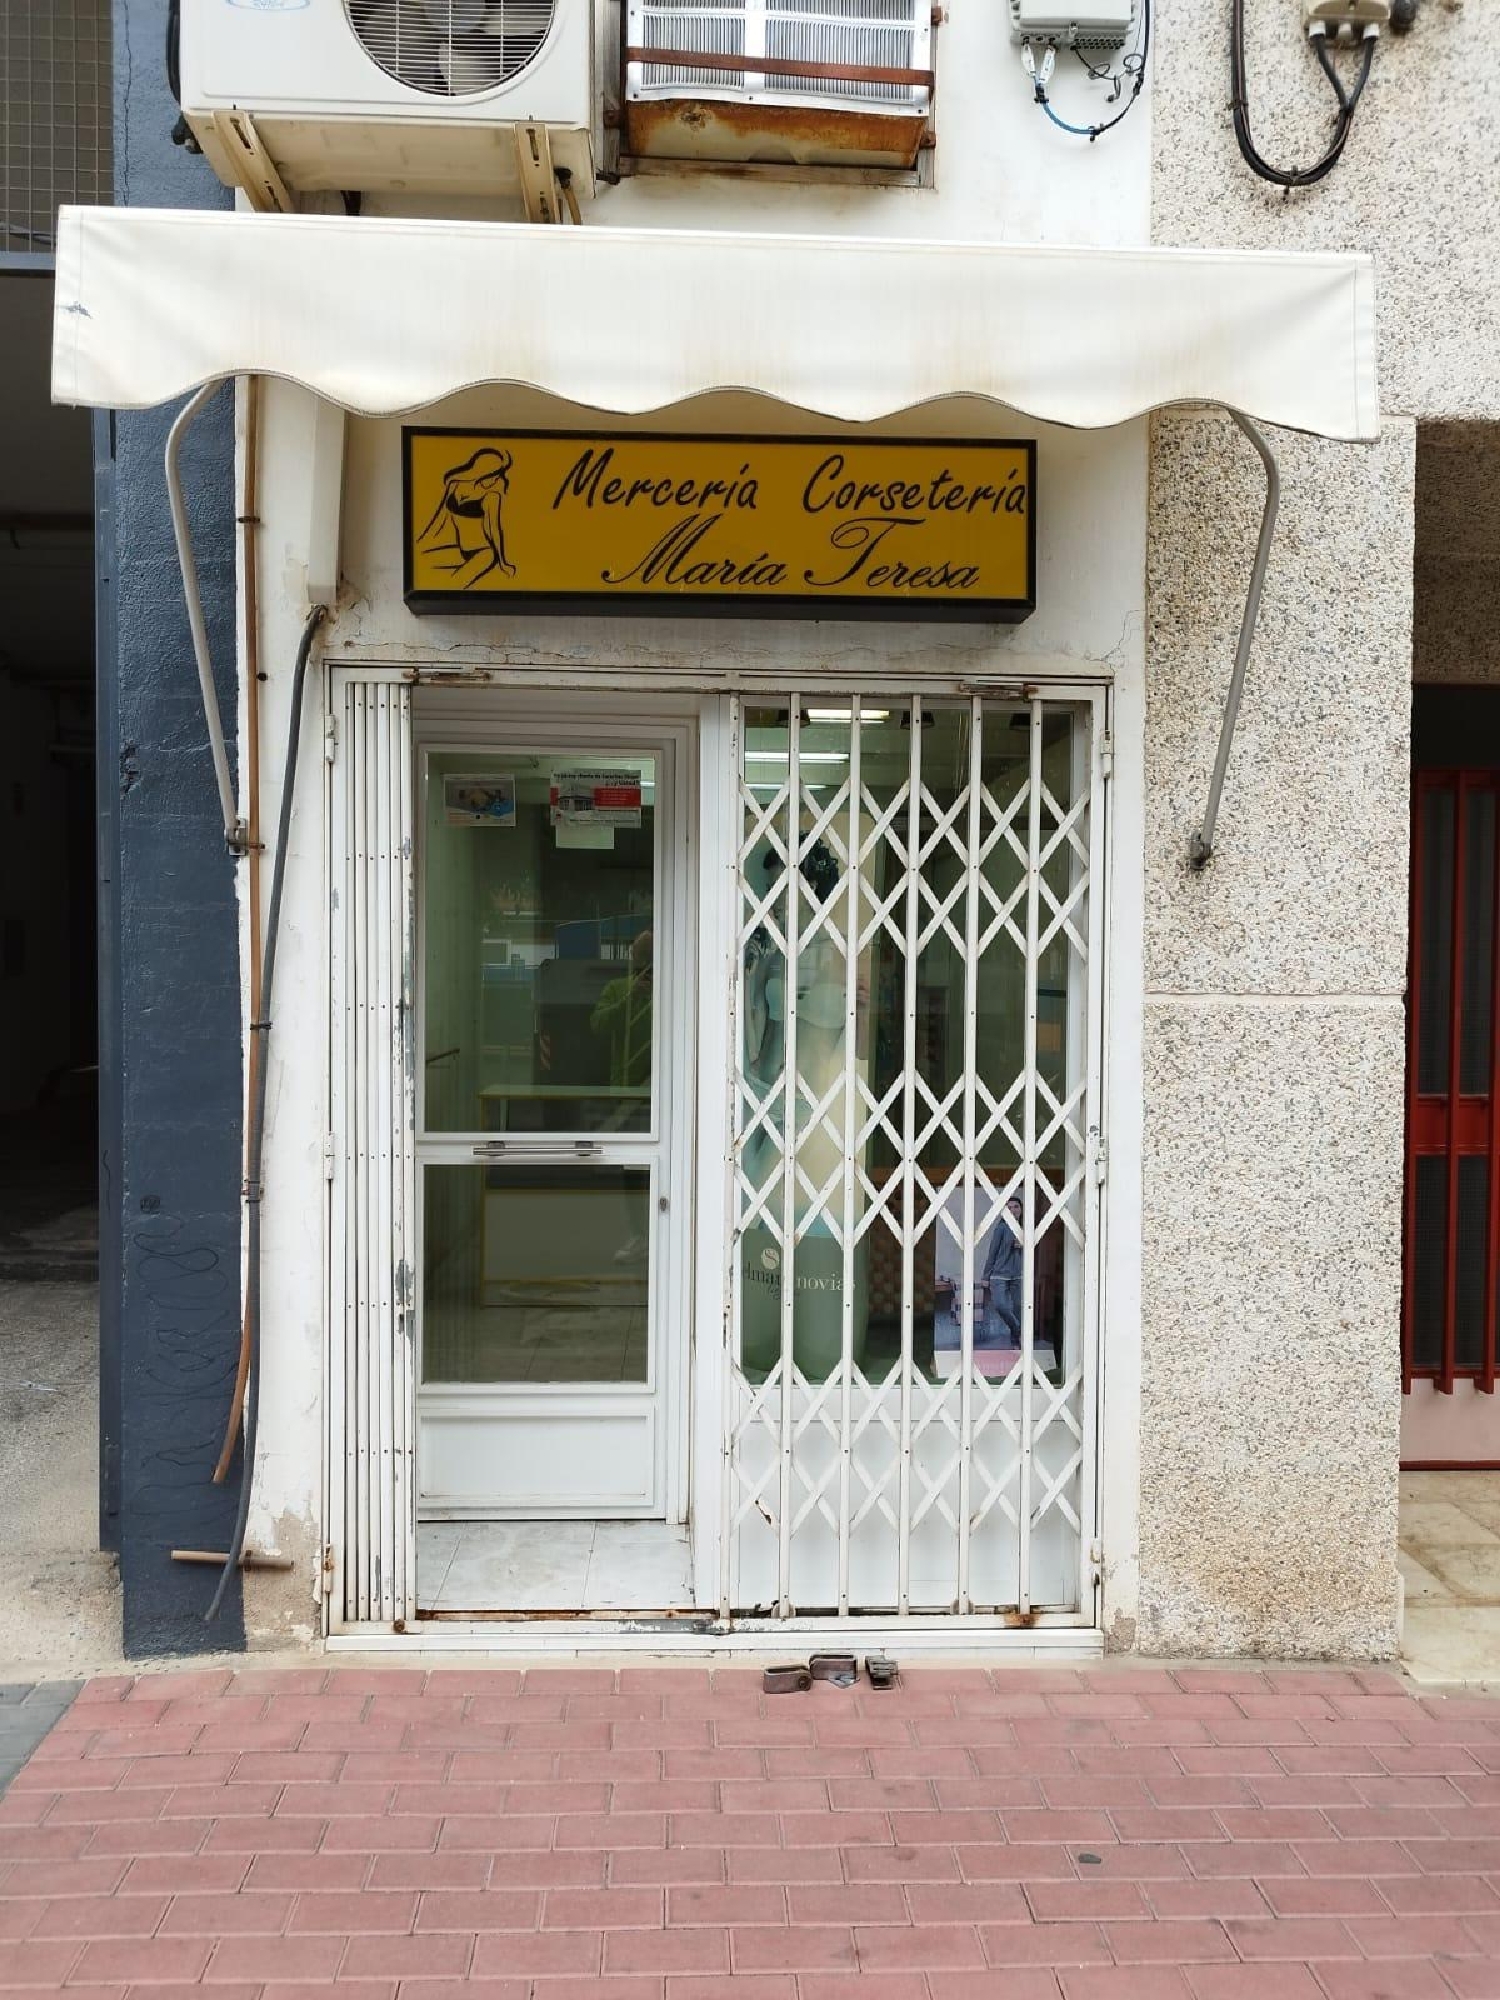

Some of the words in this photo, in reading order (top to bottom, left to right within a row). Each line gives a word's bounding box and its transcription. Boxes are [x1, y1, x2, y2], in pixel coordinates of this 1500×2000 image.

[552, 447, 759, 510] Mercería
[802, 453, 1026, 514] Corsetería
[600, 512, 787, 586] María
[803, 516, 980, 589] Teresa
